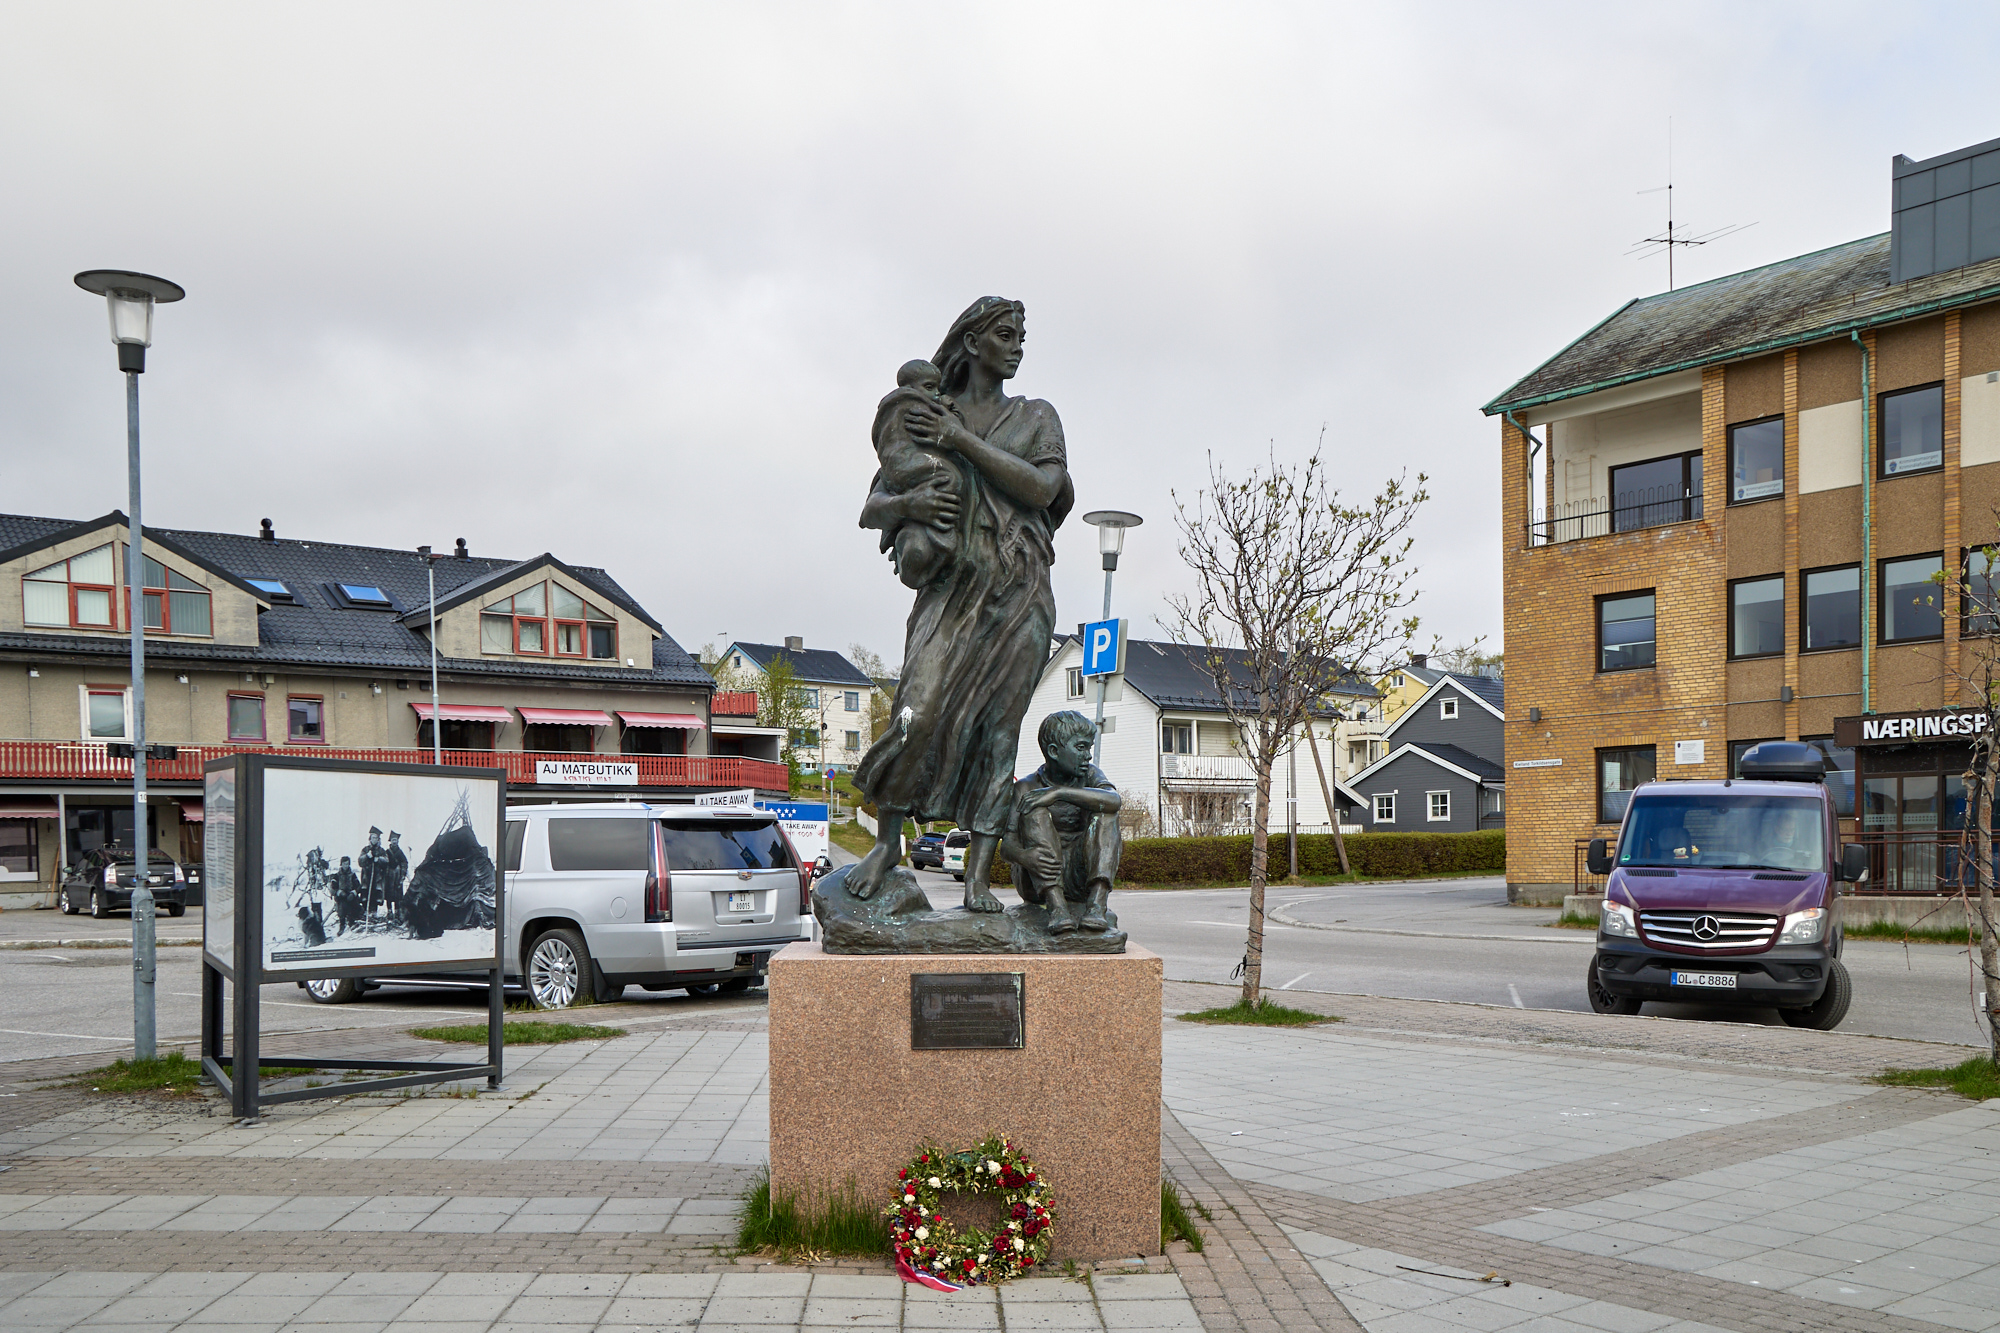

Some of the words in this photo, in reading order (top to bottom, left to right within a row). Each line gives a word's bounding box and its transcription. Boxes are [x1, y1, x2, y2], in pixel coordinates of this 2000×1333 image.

[1091, 627, 1111, 669] P
[1863, 713, 1994, 740] NÆRINGSP
[543, 763, 558, 774] AJ
[562, 764, 632, 775] MATBUTIKK
[710, 796, 727, 806] TAKE
[729, 794, 749, 804] AWAY
[1678, 974, 1691, 984] OL
[1699, 975, 1705, 985] C
[1708, 975, 1735, 986] 8886
